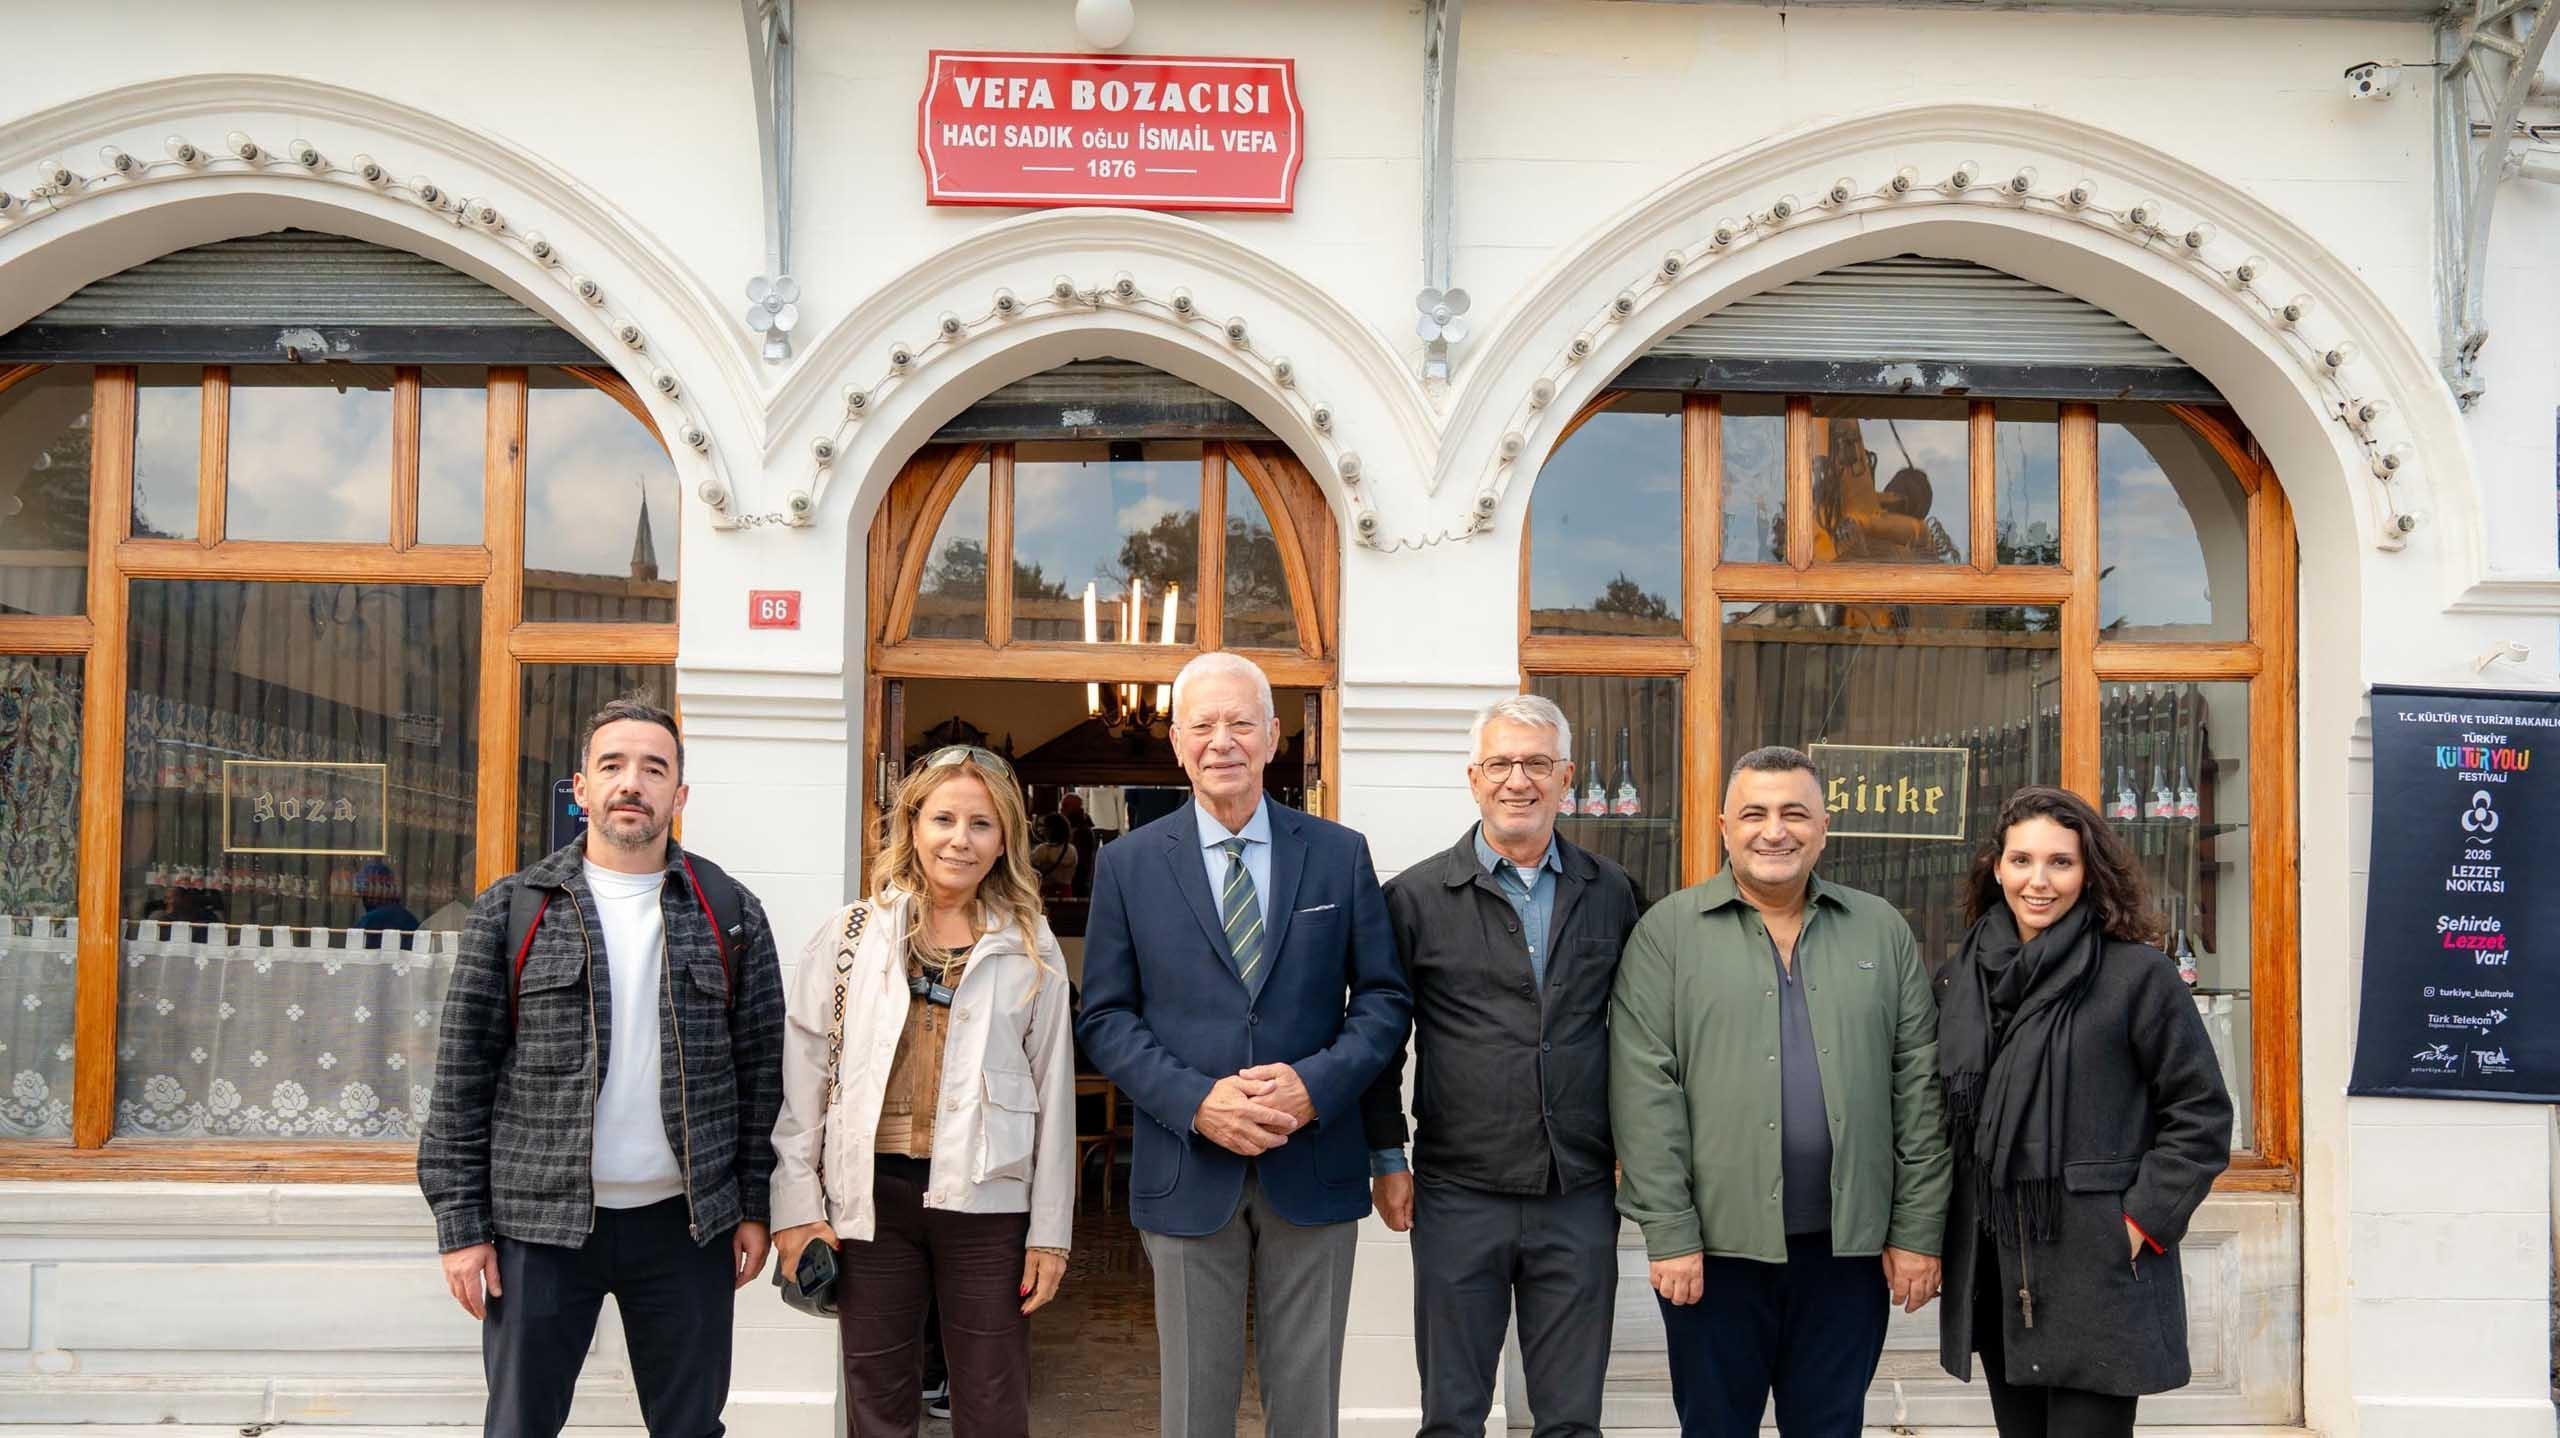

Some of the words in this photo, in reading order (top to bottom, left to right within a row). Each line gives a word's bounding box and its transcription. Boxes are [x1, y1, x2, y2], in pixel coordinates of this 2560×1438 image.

[954, 76, 1055, 109] VEFA
[1071, 80, 1270, 113] BOZACISI
[942, 123, 997, 148] HACI
[1003, 124, 1073, 149] SADIK
[1081, 126, 1129, 150] OĞLU
[1139, 123, 1215, 152] İSMAİL
[1221, 130, 1278, 153] VEFA
[1086, 159, 1137, 179] 1876
[762, 599, 788, 620] 66
[2398, 712, 2417, 722] T.C.
[2418, 712, 2457, 724] KÜLTÜR
[2460, 714, 2473, 724] VE
[2474, 714, 2513, 726] TURİZM
[2462, 732, 2507, 745] TÜRKİYE
[2458, 771, 2508, 783] FESTİVALİ
[1826, 775, 1945, 815] Sirke
[252, 791, 358, 823] Boza
[2464, 849, 2492, 861] 2026
[2451, 864, 2501, 879] LEZZET
[2445, 879, 2505, 894] NOKTASI
[2436, 915, 2502, 934] Şehirde
[2443, 932, 2506, 949] Lezzet
[2474, 950, 2509, 966] Var!
[2439, 988, 2514, 999] turkiye_kulturyolu
[2428, 1013, 2450, 1024] Türk
[2452, 1015, 2492, 1026] Telekom
[2471, 1047, 2511, 1068] TGA
